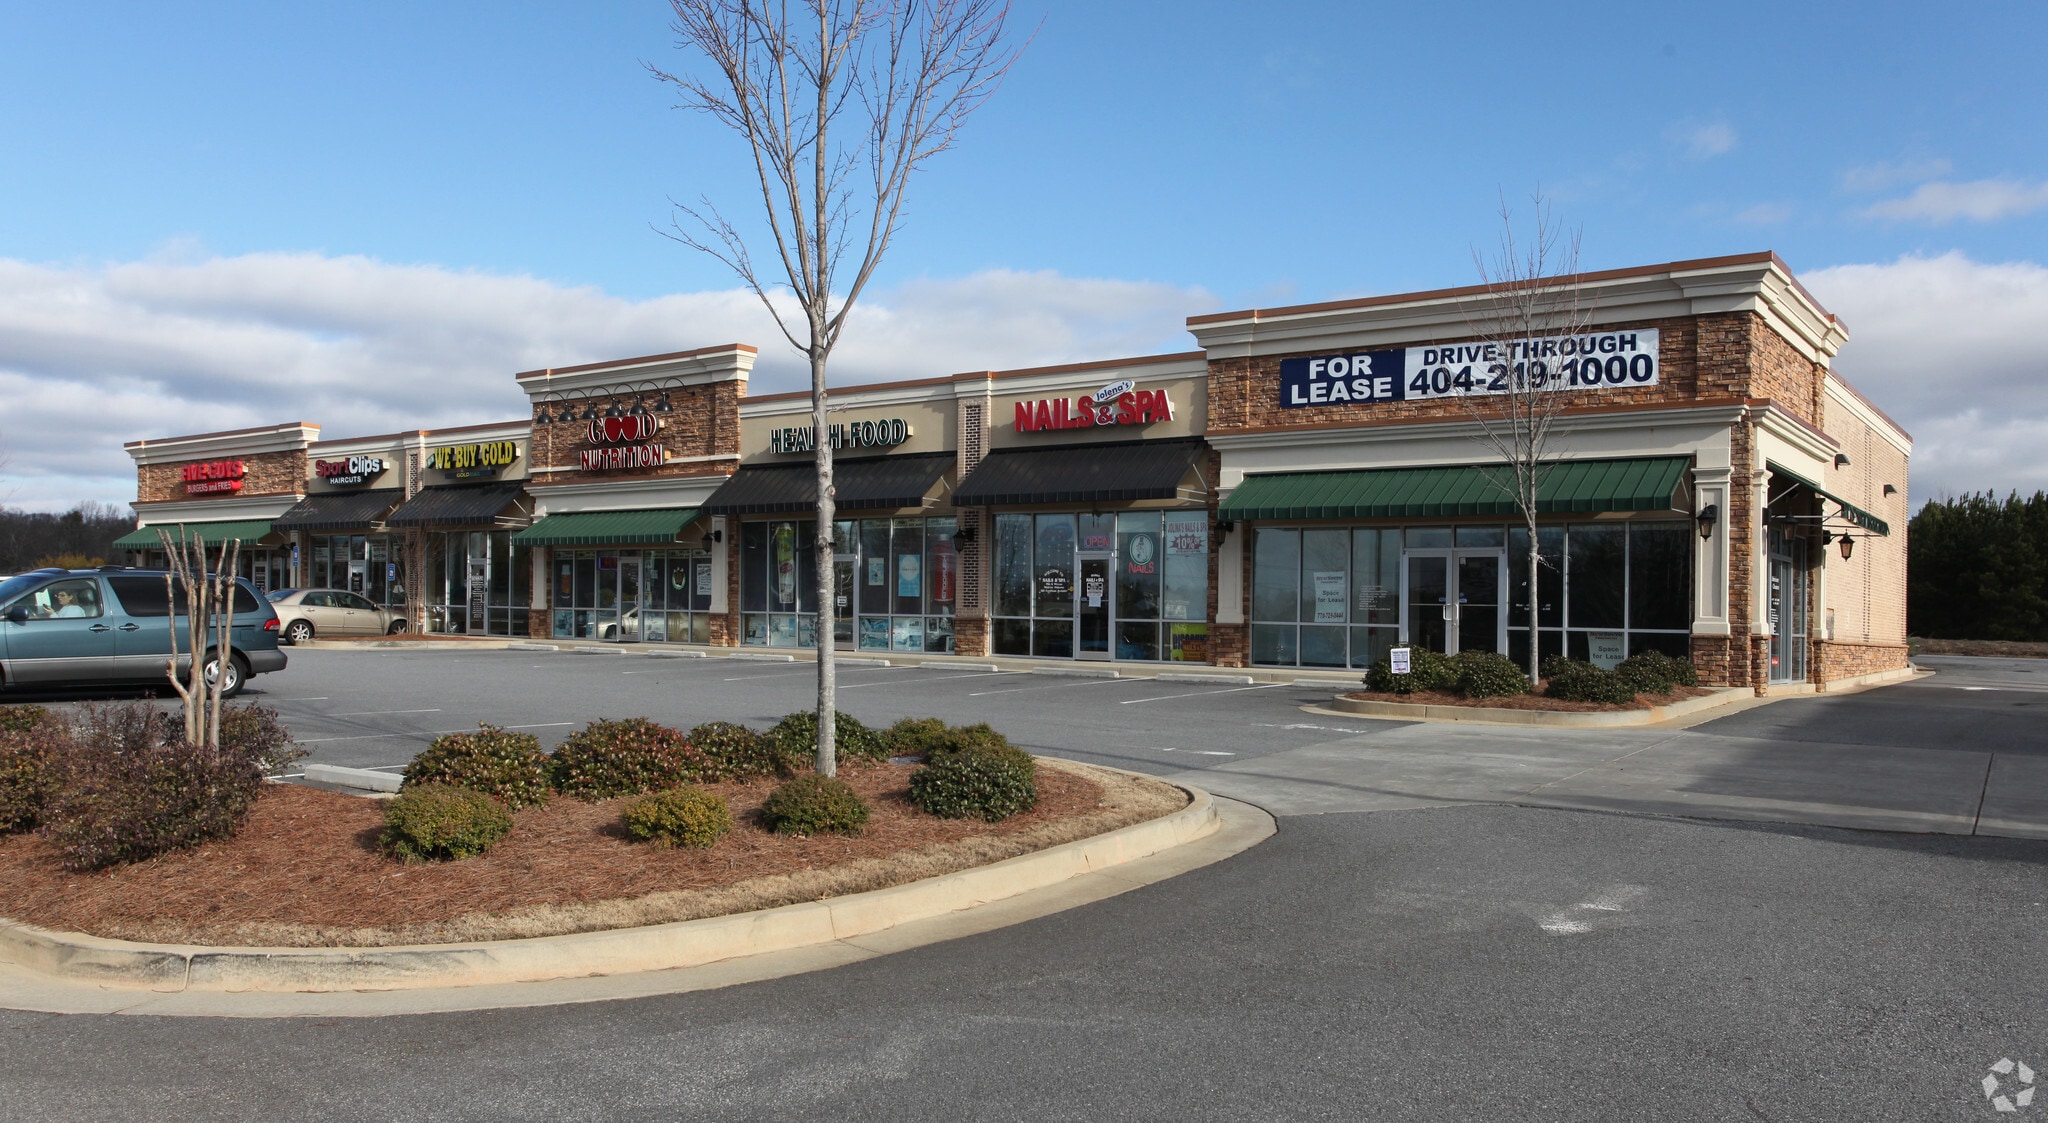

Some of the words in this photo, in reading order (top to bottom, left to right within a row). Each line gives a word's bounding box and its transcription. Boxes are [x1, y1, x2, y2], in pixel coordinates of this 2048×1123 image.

[1309, 355, 1373, 380] FOR
[1409, 353, 1654, 395] 404-219-1000
[1095, 381, 1130, 401] Jolena's
[1291, 376, 1393, 405] LEASE
[1015, 395, 1096, 432] NAILS
[1096, 405, 1116, 425] &
[1117, 389, 1174, 425] SPA
[587, 412, 657, 444] GOOD
[769, 424, 843, 453] HEALH
[850, 418, 906, 448] FOOD
[434, 447, 452, 469] WE
[455, 444, 477, 468] BUY
[481, 441, 514, 466] GOLD
[580, 444, 663, 471] NUTRITION
[180, 462, 208, 481] FIVE
[208, 460, 243, 479] GUYS
[329, 476, 362, 484] HAIRCUTS
[187, 484, 209, 493] BURGERS
[209, 483, 217, 491] and
[217, 481, 231, 490] FRIES
[1085, 536, 1111, 547] OPEN
[1176, 537, 1195, 549] 10%
[1128, 562, 1155, 574] NAILS
